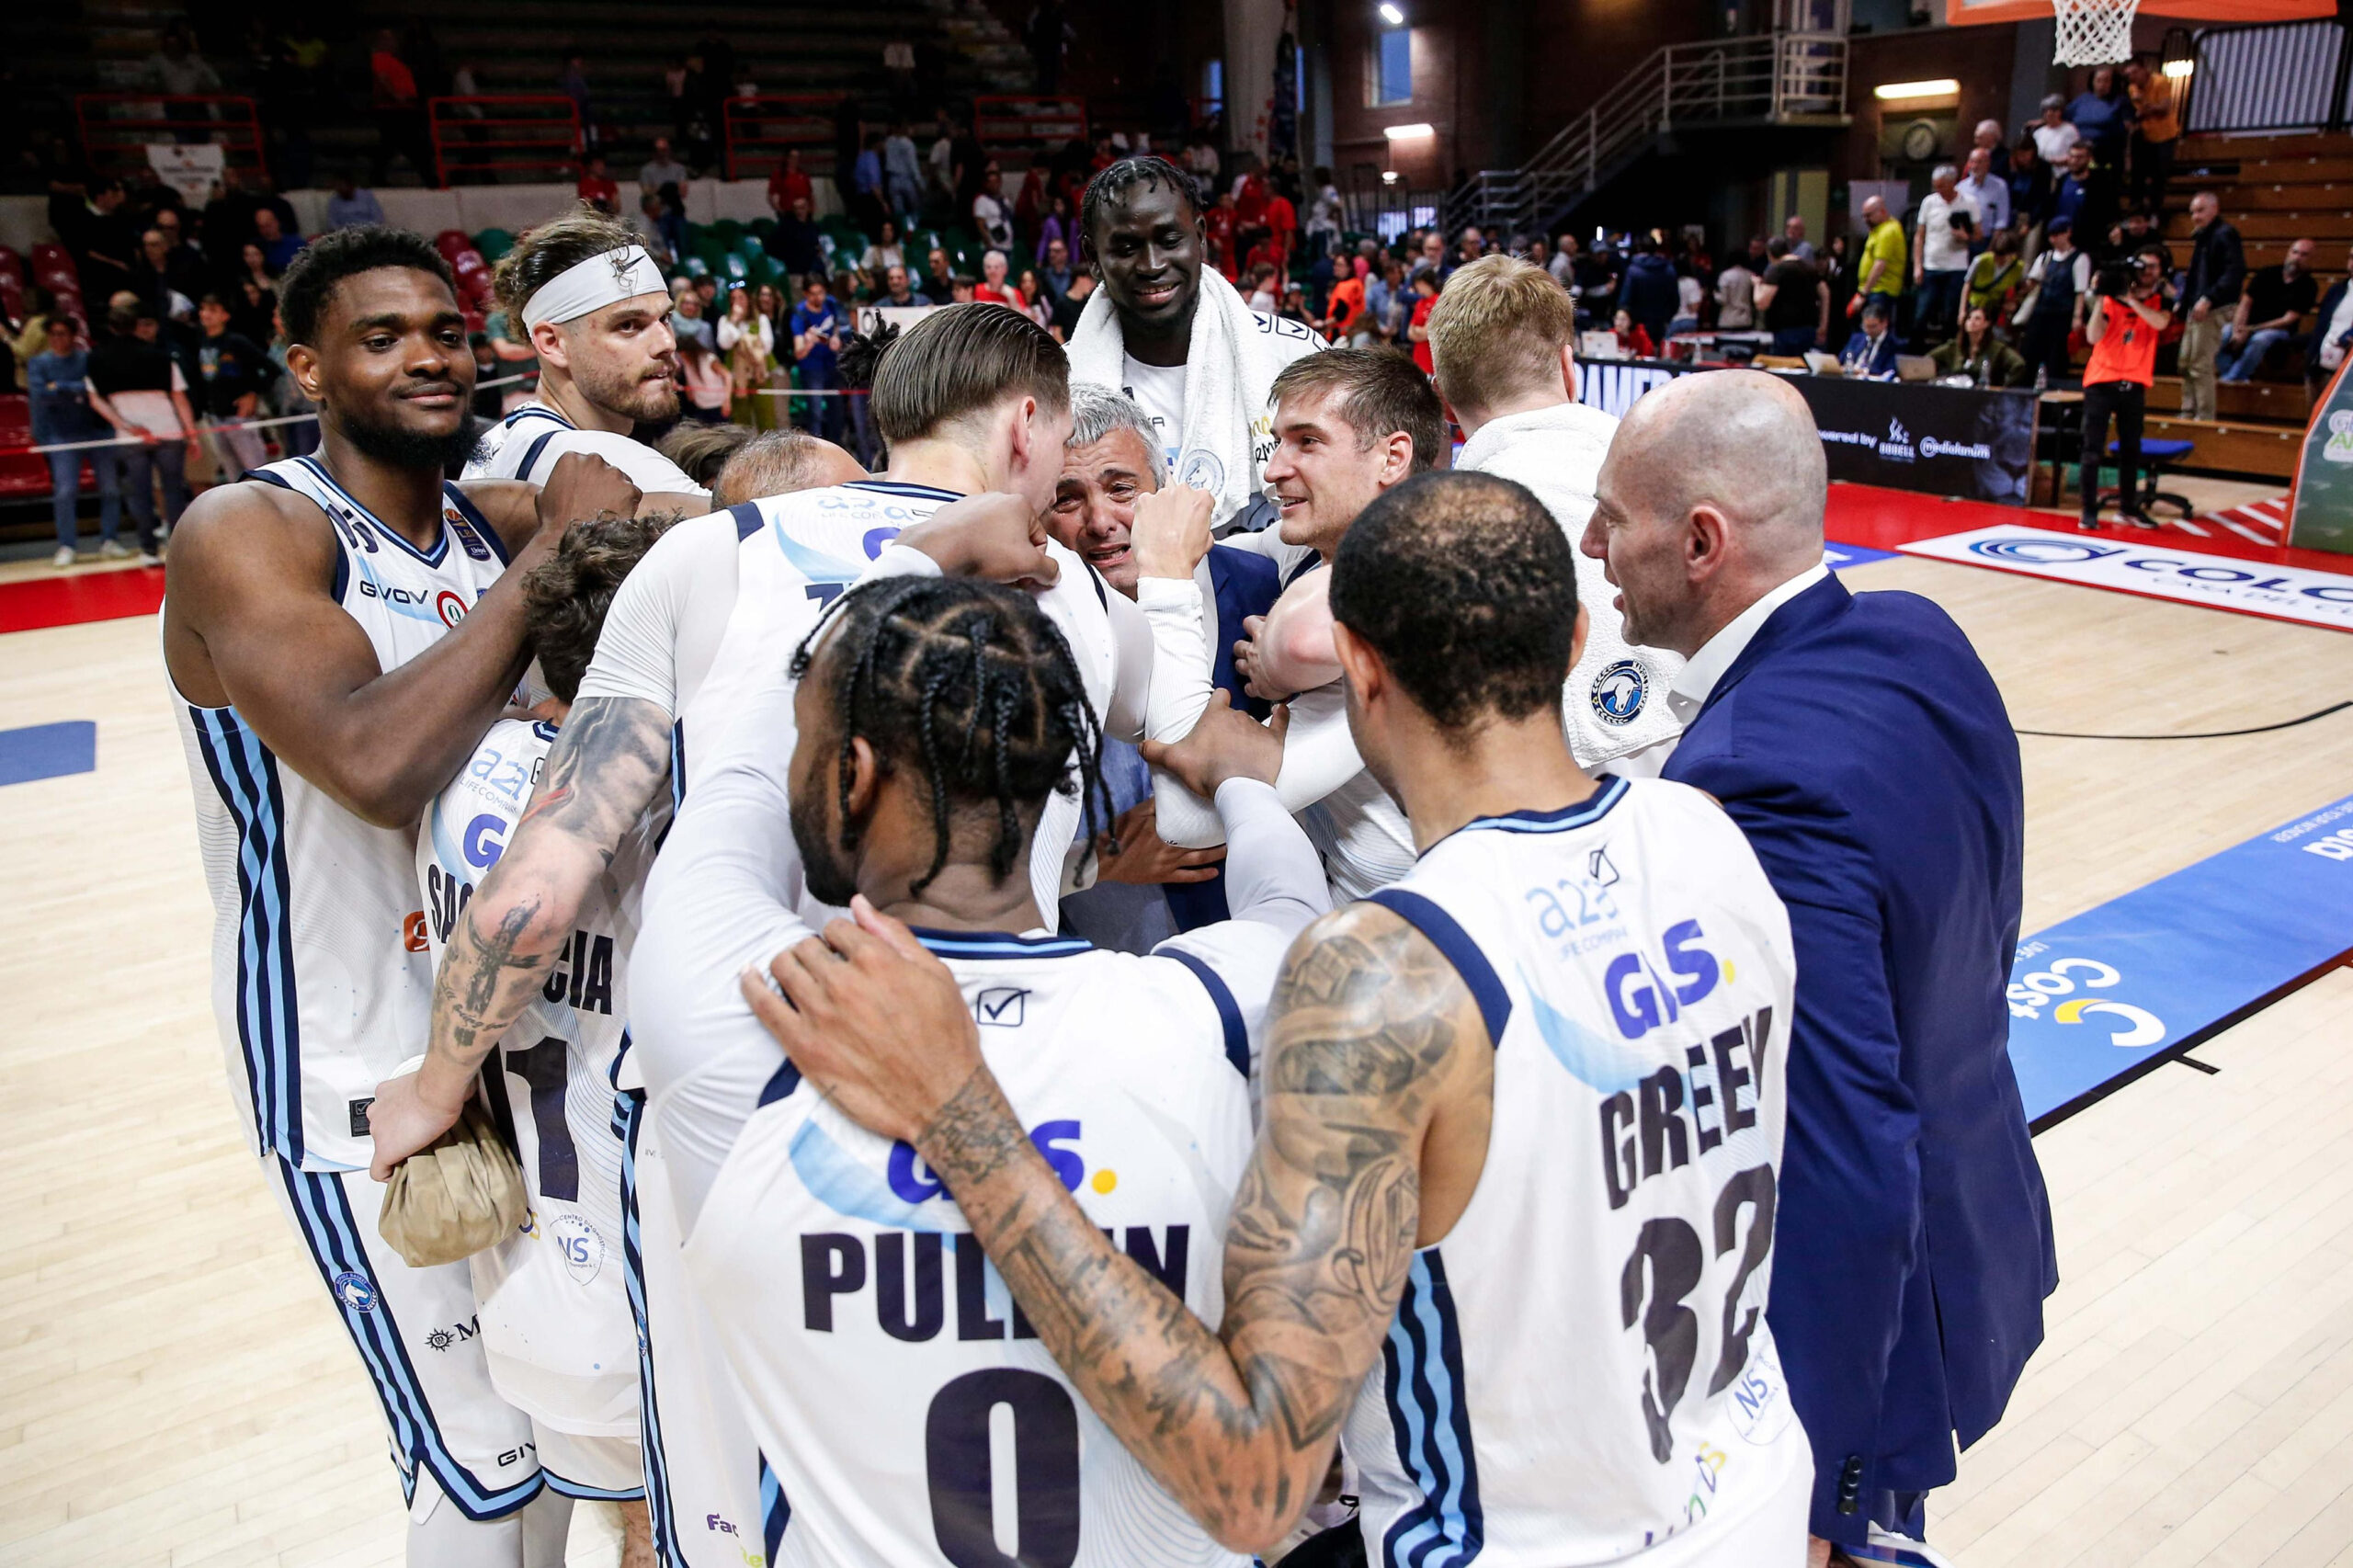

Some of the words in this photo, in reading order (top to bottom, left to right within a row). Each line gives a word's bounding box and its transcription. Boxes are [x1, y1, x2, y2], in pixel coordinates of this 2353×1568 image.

[478, 786, 517, 814] COMP
[800, 1224, 1190, 1343] PULN
[1620, 1162, 1777, 1465] 32
[1733, 1369, 1768, 1420] NS
[926, 1368, 1081, 1568] 0
